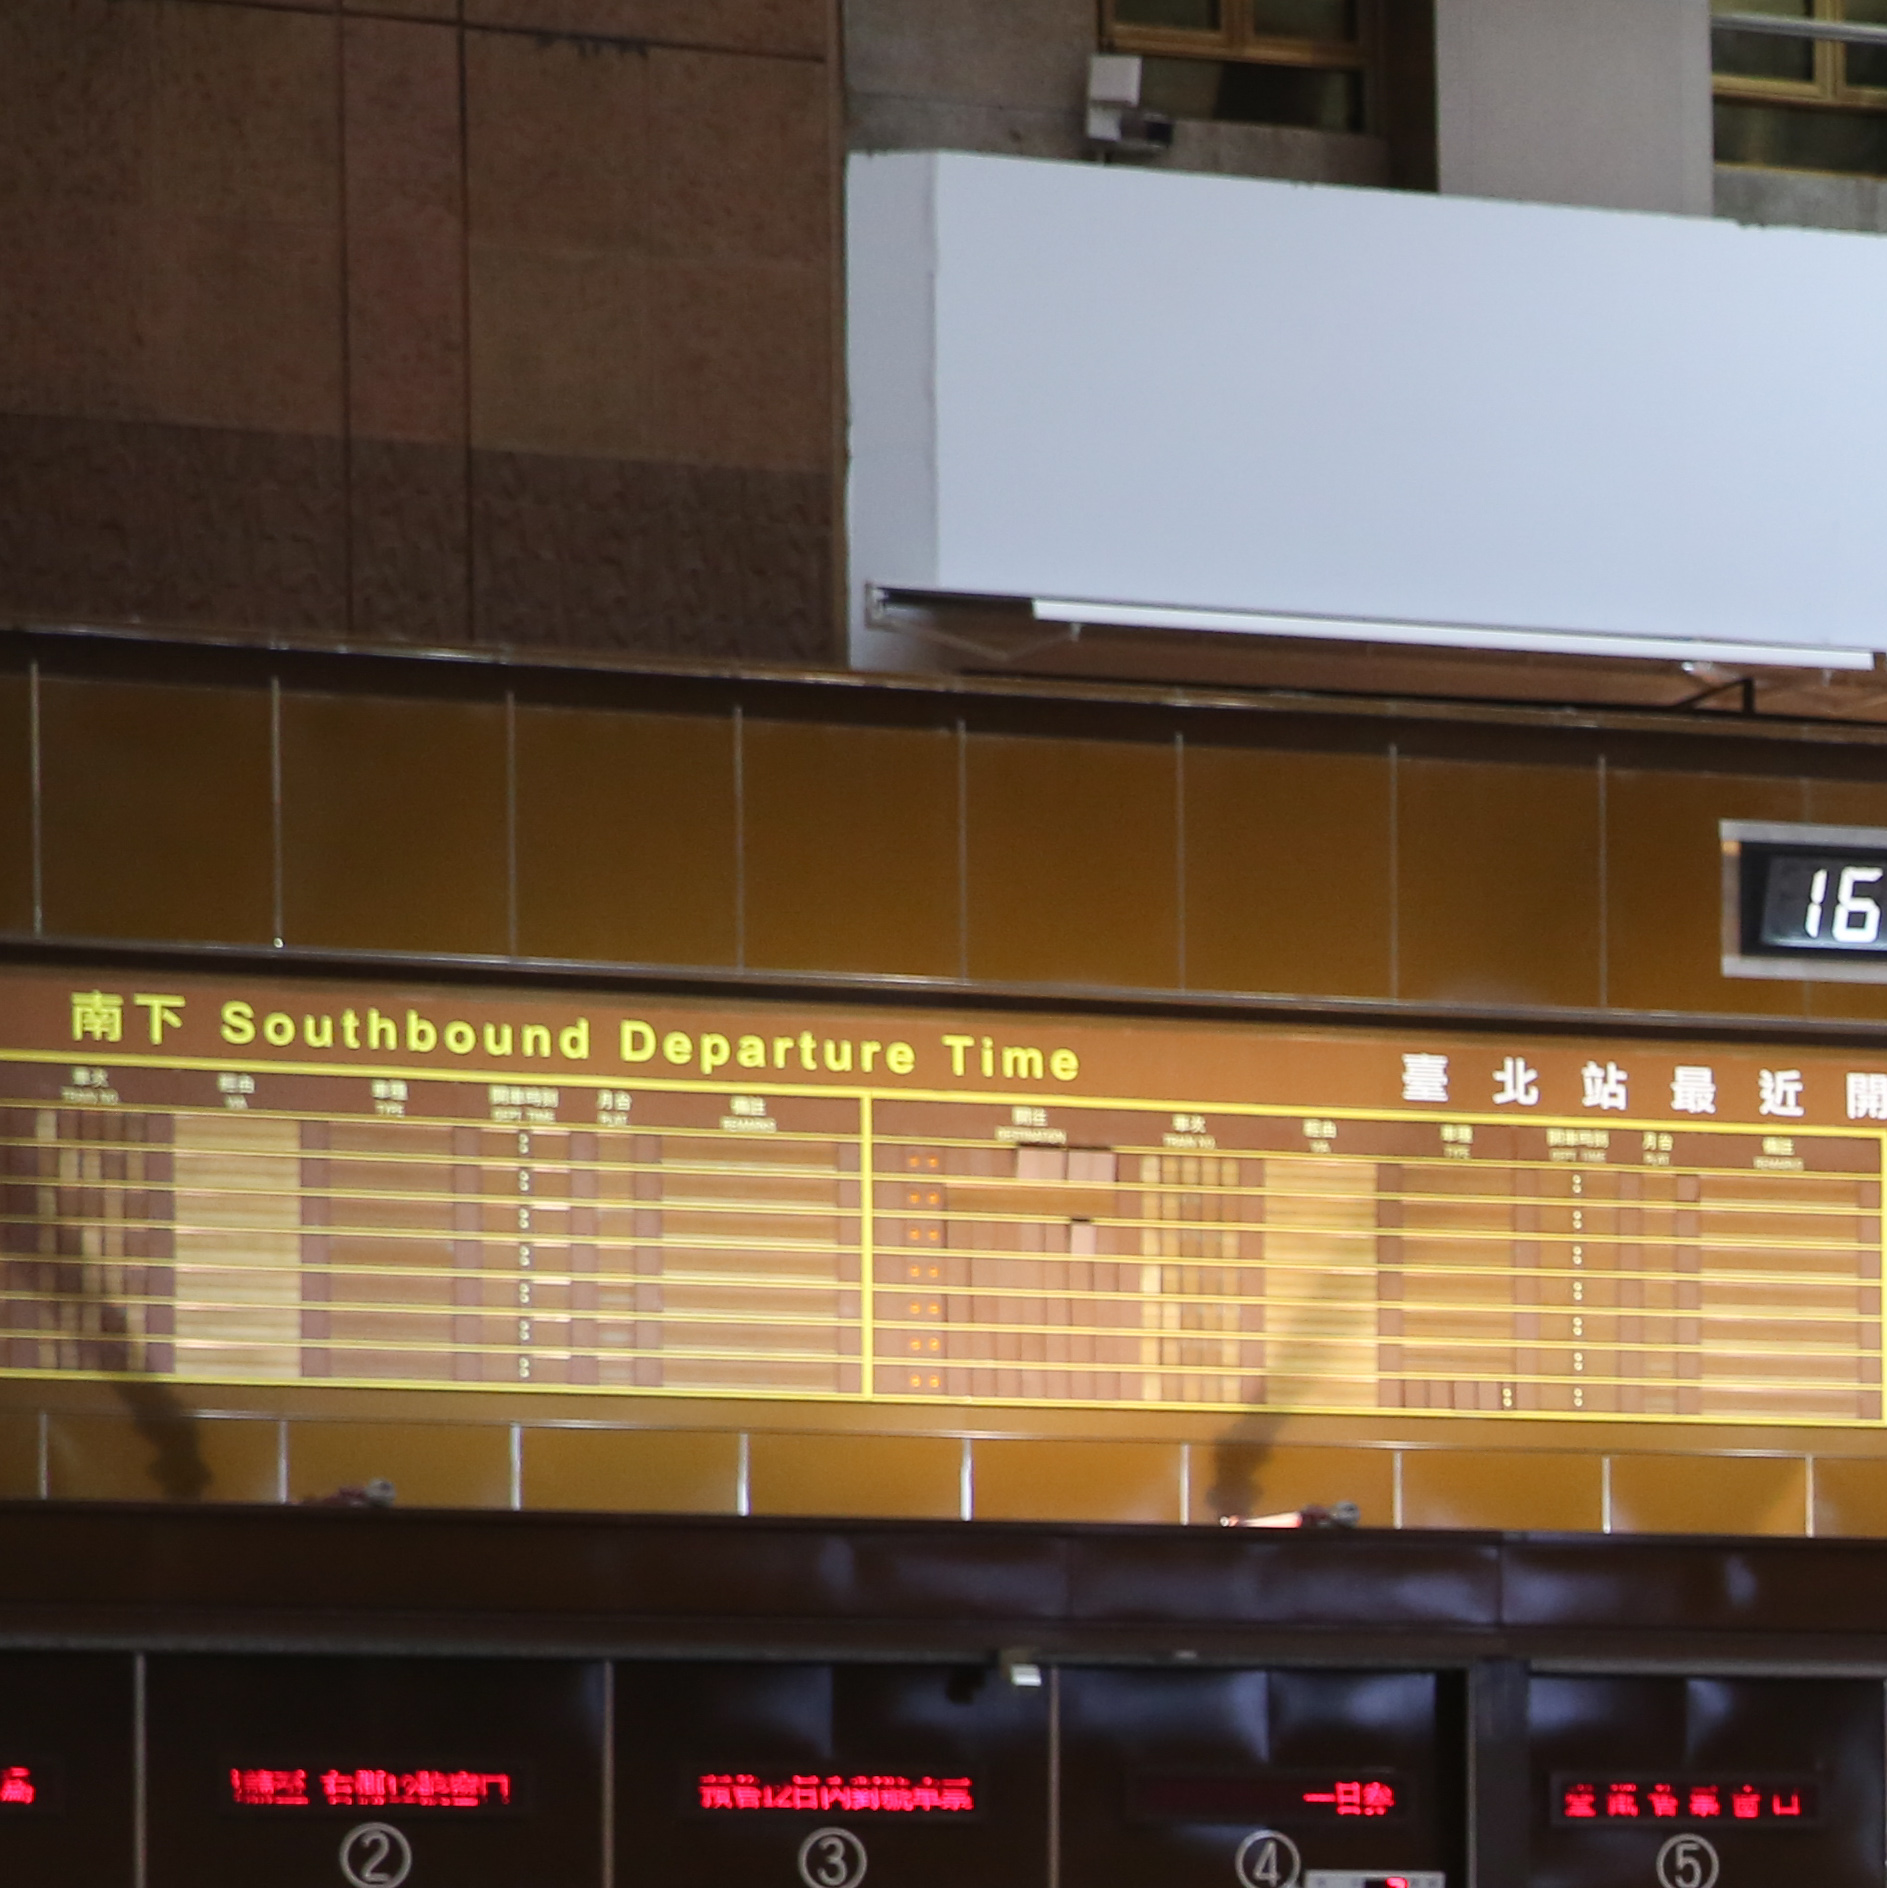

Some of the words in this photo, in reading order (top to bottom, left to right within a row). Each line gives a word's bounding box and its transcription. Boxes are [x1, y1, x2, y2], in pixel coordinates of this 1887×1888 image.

[71, 990, 187, 1046] 南下
[221, 1000, 592, 1062] Southbound
[619, 1018, 917, 1076] Departure
[941, 1033, 1081, 1081] Time
